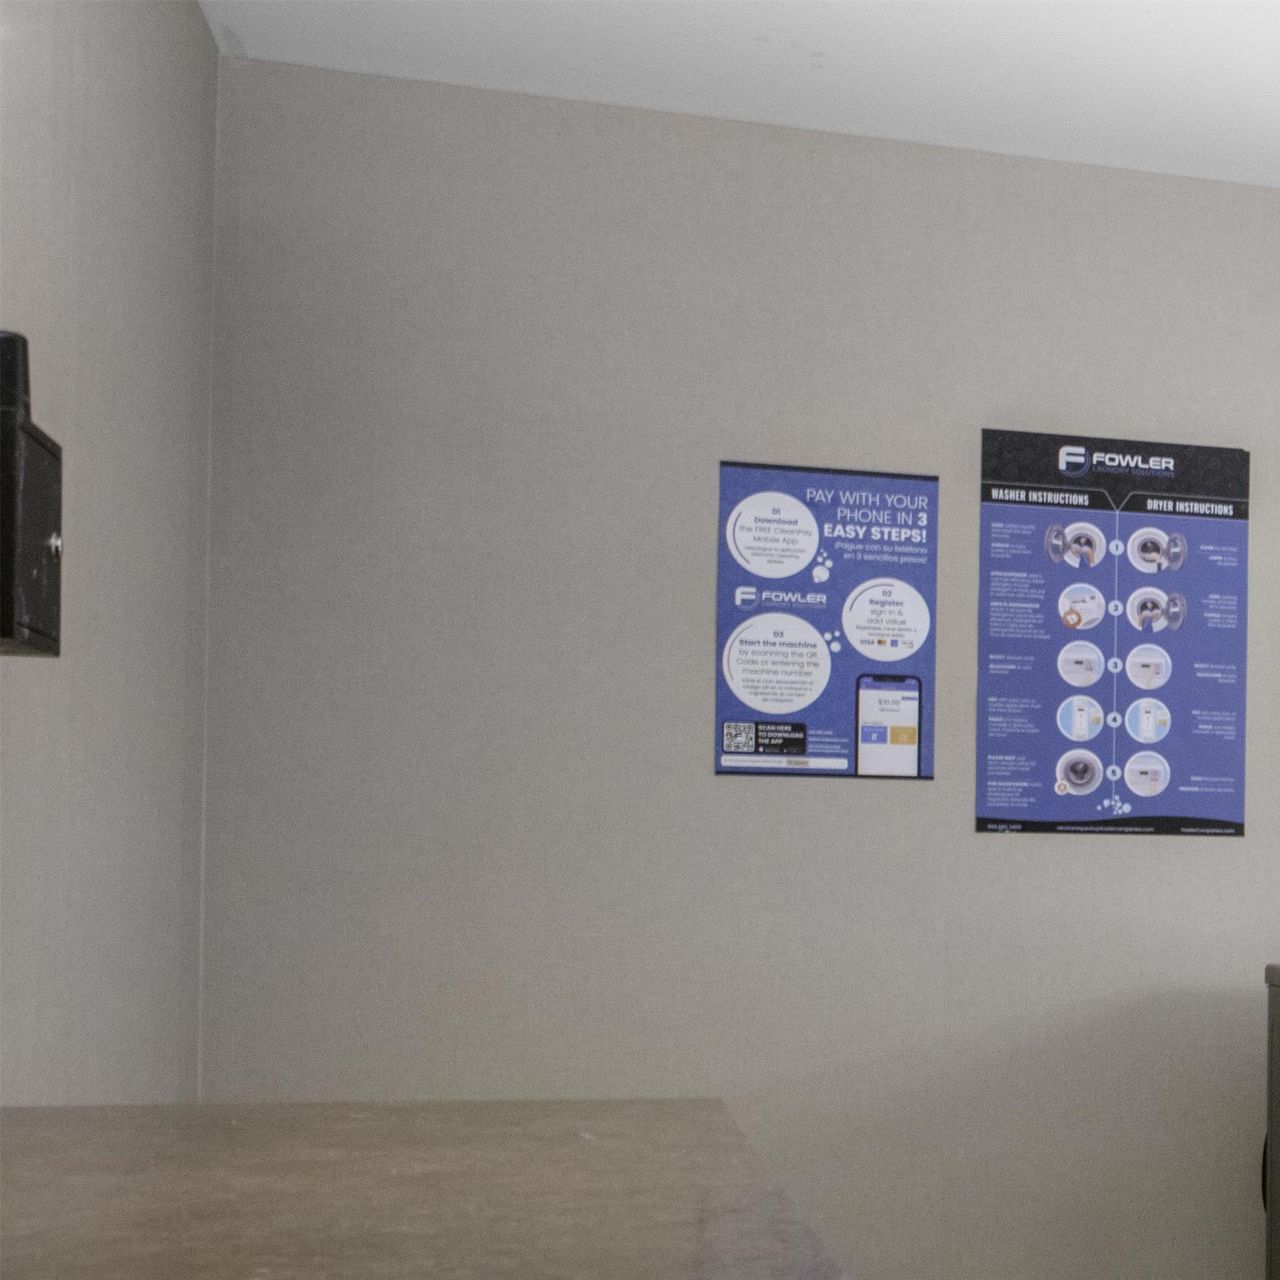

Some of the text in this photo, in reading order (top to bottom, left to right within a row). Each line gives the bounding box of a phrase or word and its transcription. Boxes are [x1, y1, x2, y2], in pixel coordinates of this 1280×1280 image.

[1093, 453, 1174, 471] FOWLER
[806, 488, 928, 510] PAY WITH YOUR
[991, 488, 1089, 506] WASHER INSTRUCTIONS
[837, 506, 928, 526] PHONE IN 3
[1147, 499, 1234, 516] DRYER INSTRUCTIONS
[754, 517, 798, 525] Download
[823, 523, 927, 543] EASY STEPS!
[761, 590, 827, 604] FOWLER
[869, 599, 904, 608] Register
[779, 641, 817, 649] machine
